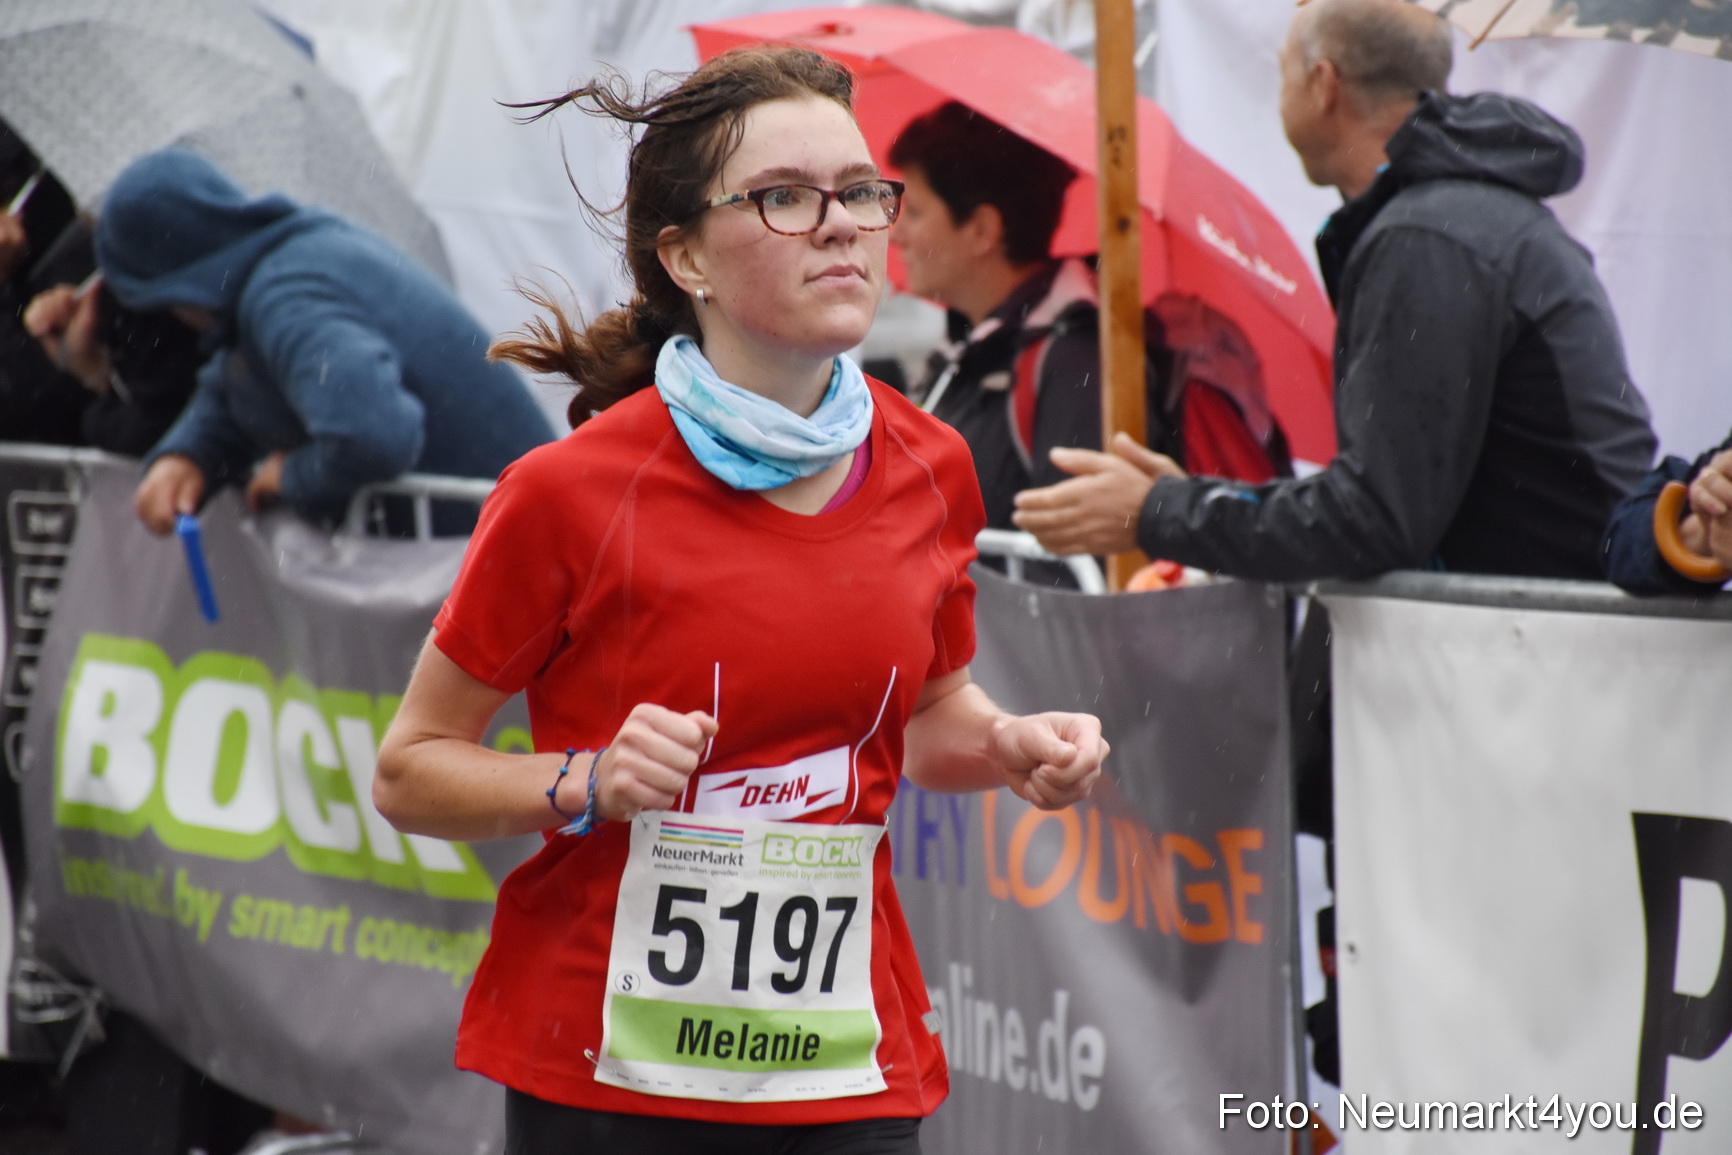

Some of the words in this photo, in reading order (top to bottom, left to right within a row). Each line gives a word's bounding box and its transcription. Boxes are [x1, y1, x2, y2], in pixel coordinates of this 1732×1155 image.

[740, 774, 811, 808] DEHN
[652, 844, 744, 867] NeuerMarkt
[761, 833, 863, 867] BOCK
[982, 790, 1264, 944] LOUNGE
[760, 867, 798, 879] inspired
[801, 869, 811, 880] by
[228, 894, 350, 955] smart
[647, 884, 858, 994] 5197
[675, 1016, 820, 1062] Melanie
